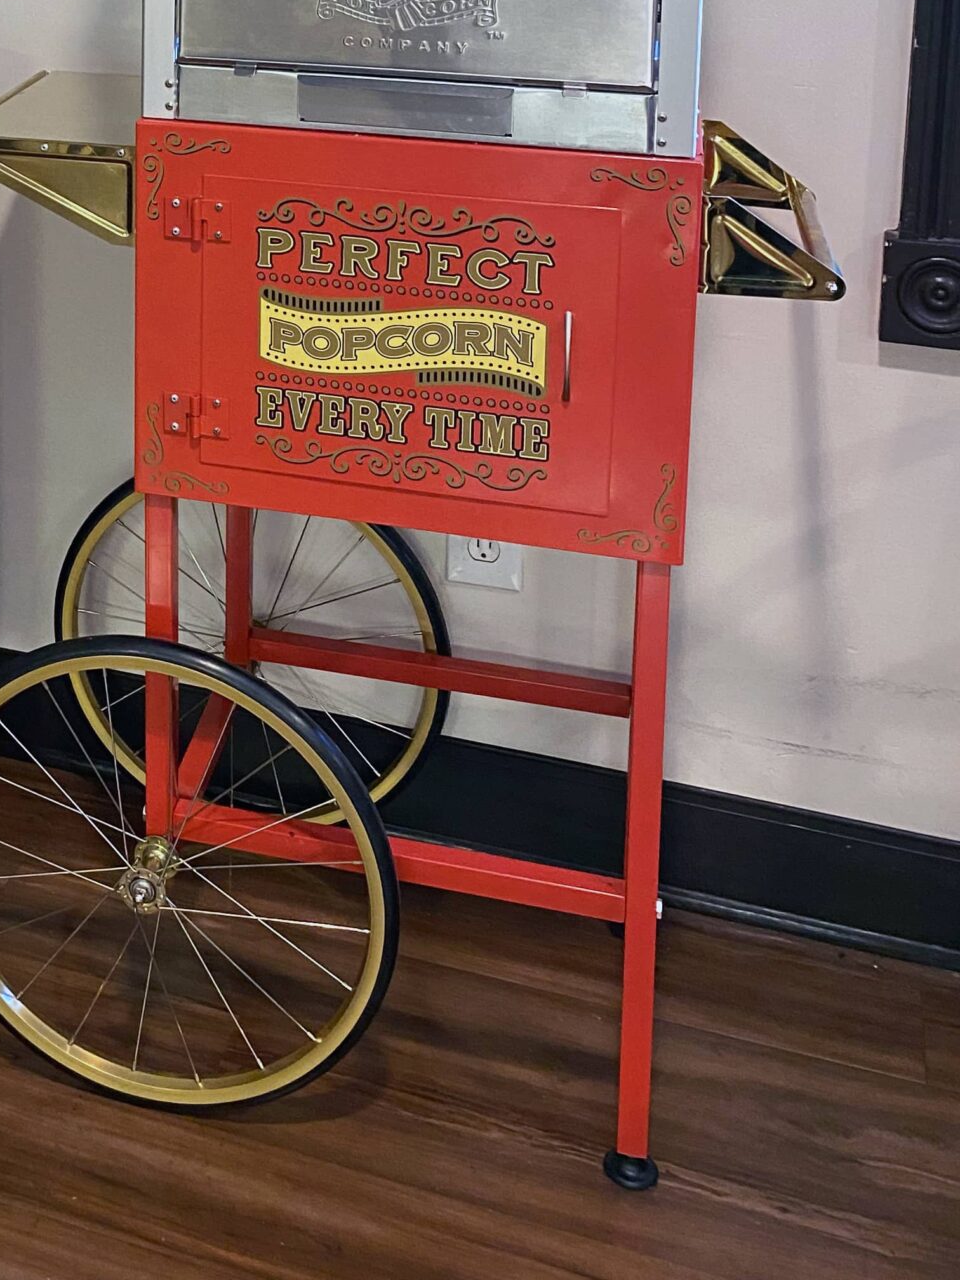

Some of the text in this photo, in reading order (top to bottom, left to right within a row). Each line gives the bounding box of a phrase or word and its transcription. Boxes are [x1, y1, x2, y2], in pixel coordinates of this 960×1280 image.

[343, 35, 470, 56] COMPANY
[256, 227, 555, 295] PERFECT
[268, 318, 535, 367] POPCORN
[255, 386, 550, 461] EVERY TIME
